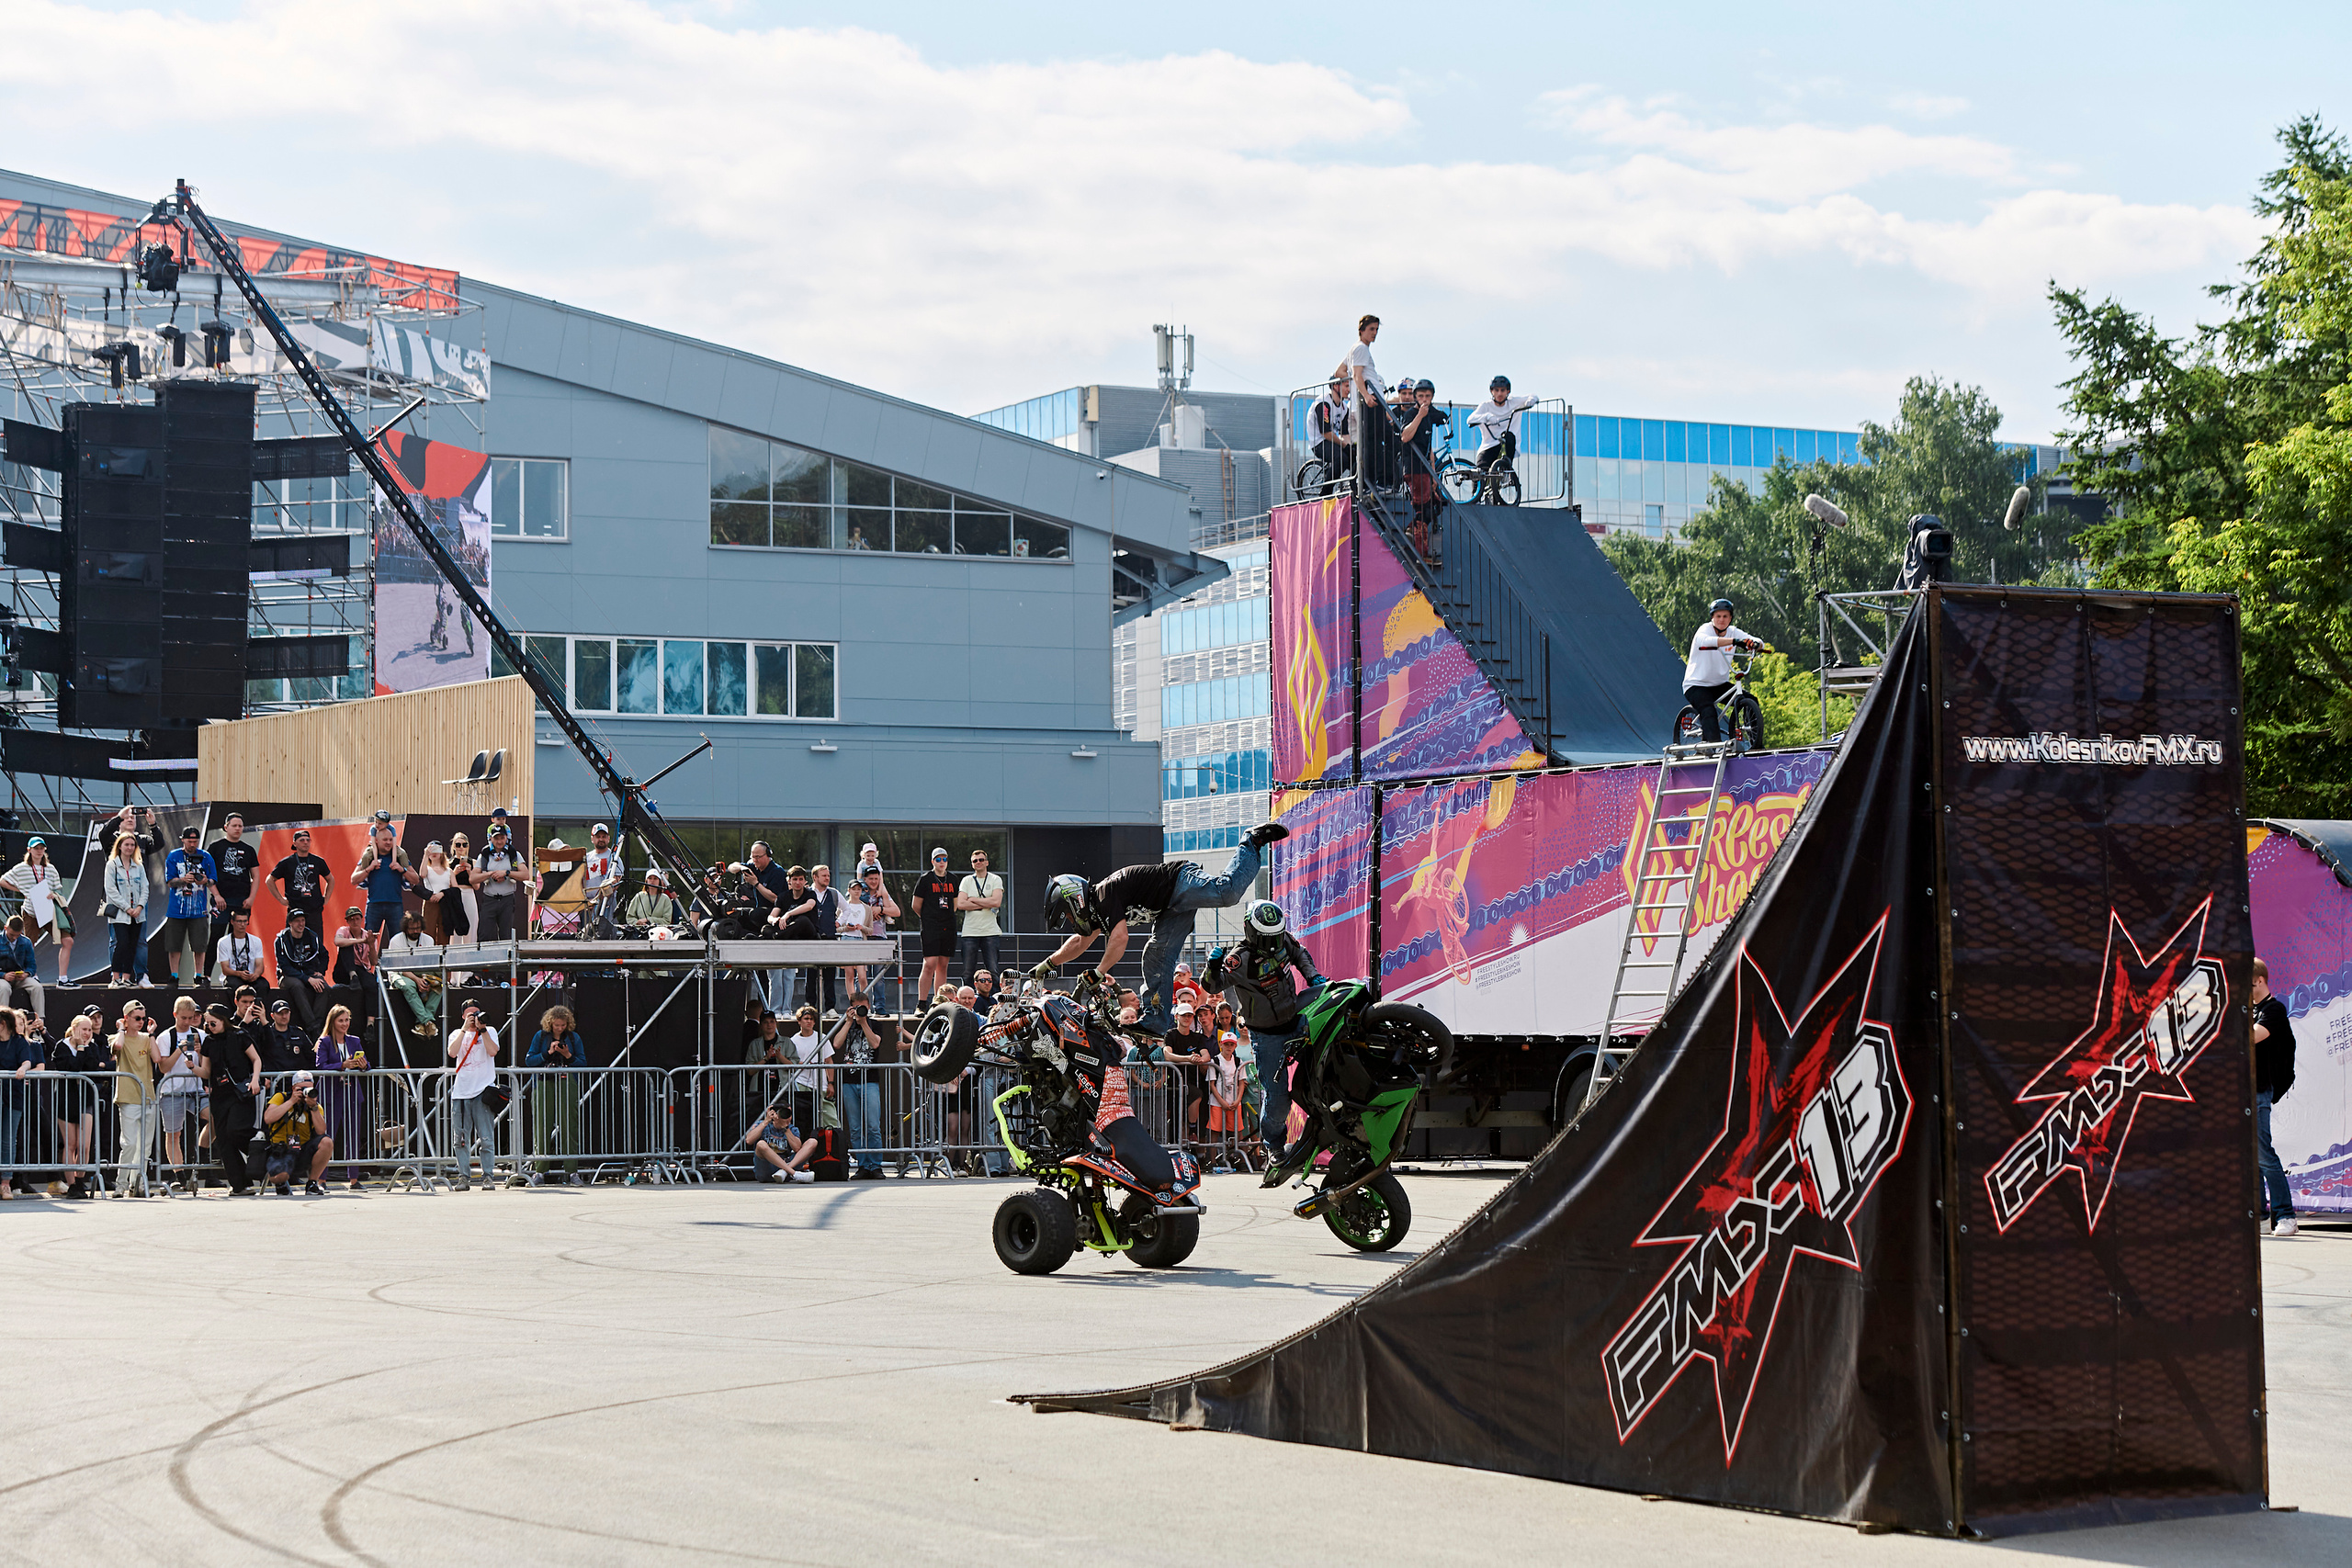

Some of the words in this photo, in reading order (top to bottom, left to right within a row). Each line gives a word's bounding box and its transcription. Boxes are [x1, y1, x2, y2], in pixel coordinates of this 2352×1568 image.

[1962, 732, 2222, 766] www.KolesnikovFMX.ru
[1475, 960, 1521, 983] #FREESTYLEBIKESHOW
[1476, 953, 1521, 975] FREESTYLESHOW.RU
[1073, 1068, 1101, 1099] LEGEND
[1180, 1152, 1192, 1182] LEGEND
